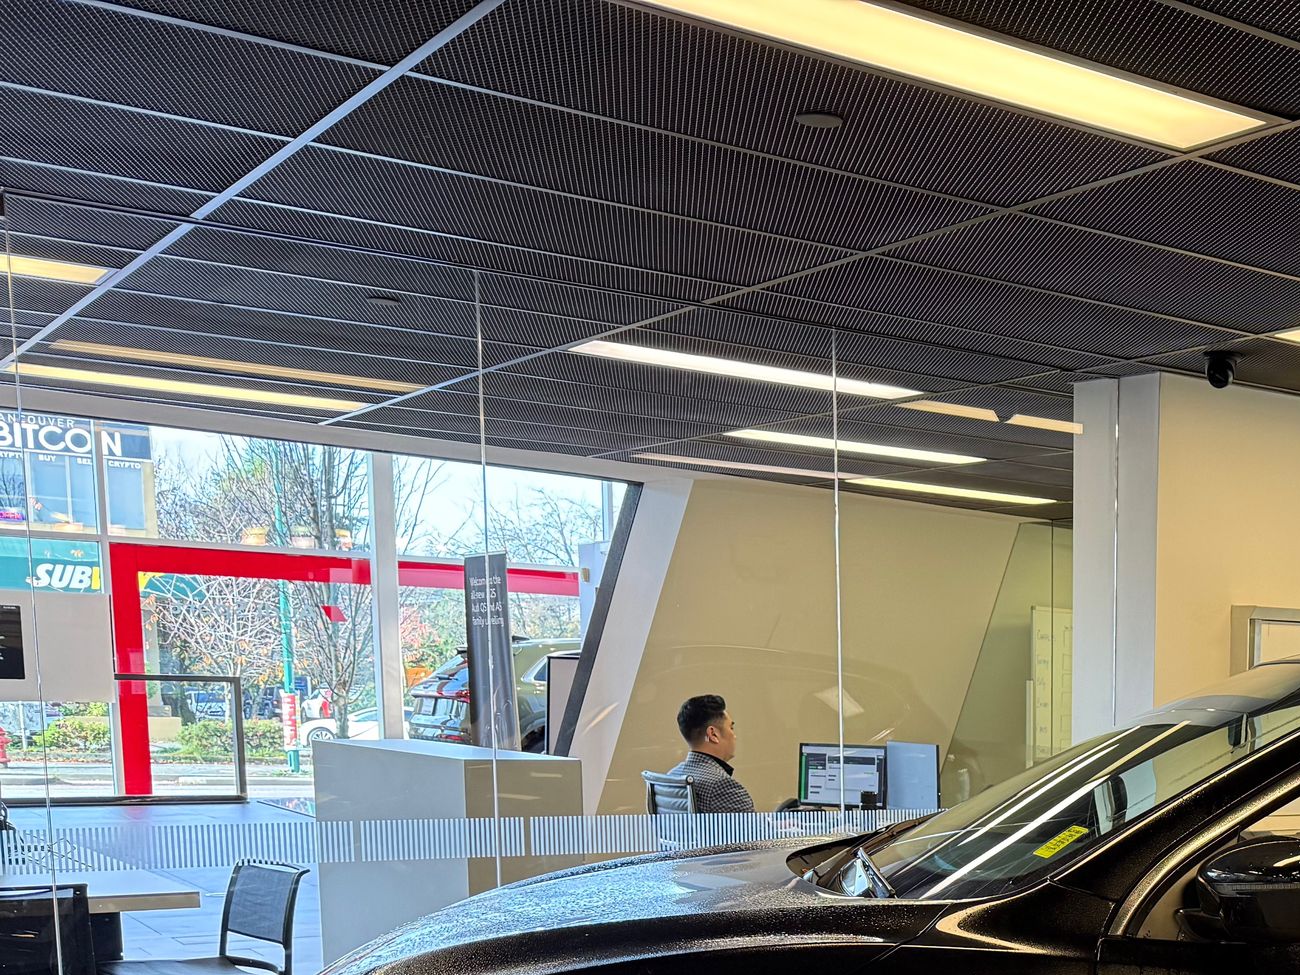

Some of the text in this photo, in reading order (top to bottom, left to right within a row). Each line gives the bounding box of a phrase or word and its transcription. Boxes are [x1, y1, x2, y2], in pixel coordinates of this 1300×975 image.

[0, 422, 122, 456] BITCON
[38, 454, 56, 463] BUY
[108, 460, 141, 469] CRYPTO
[469, 577, 489, 586] Welcom
